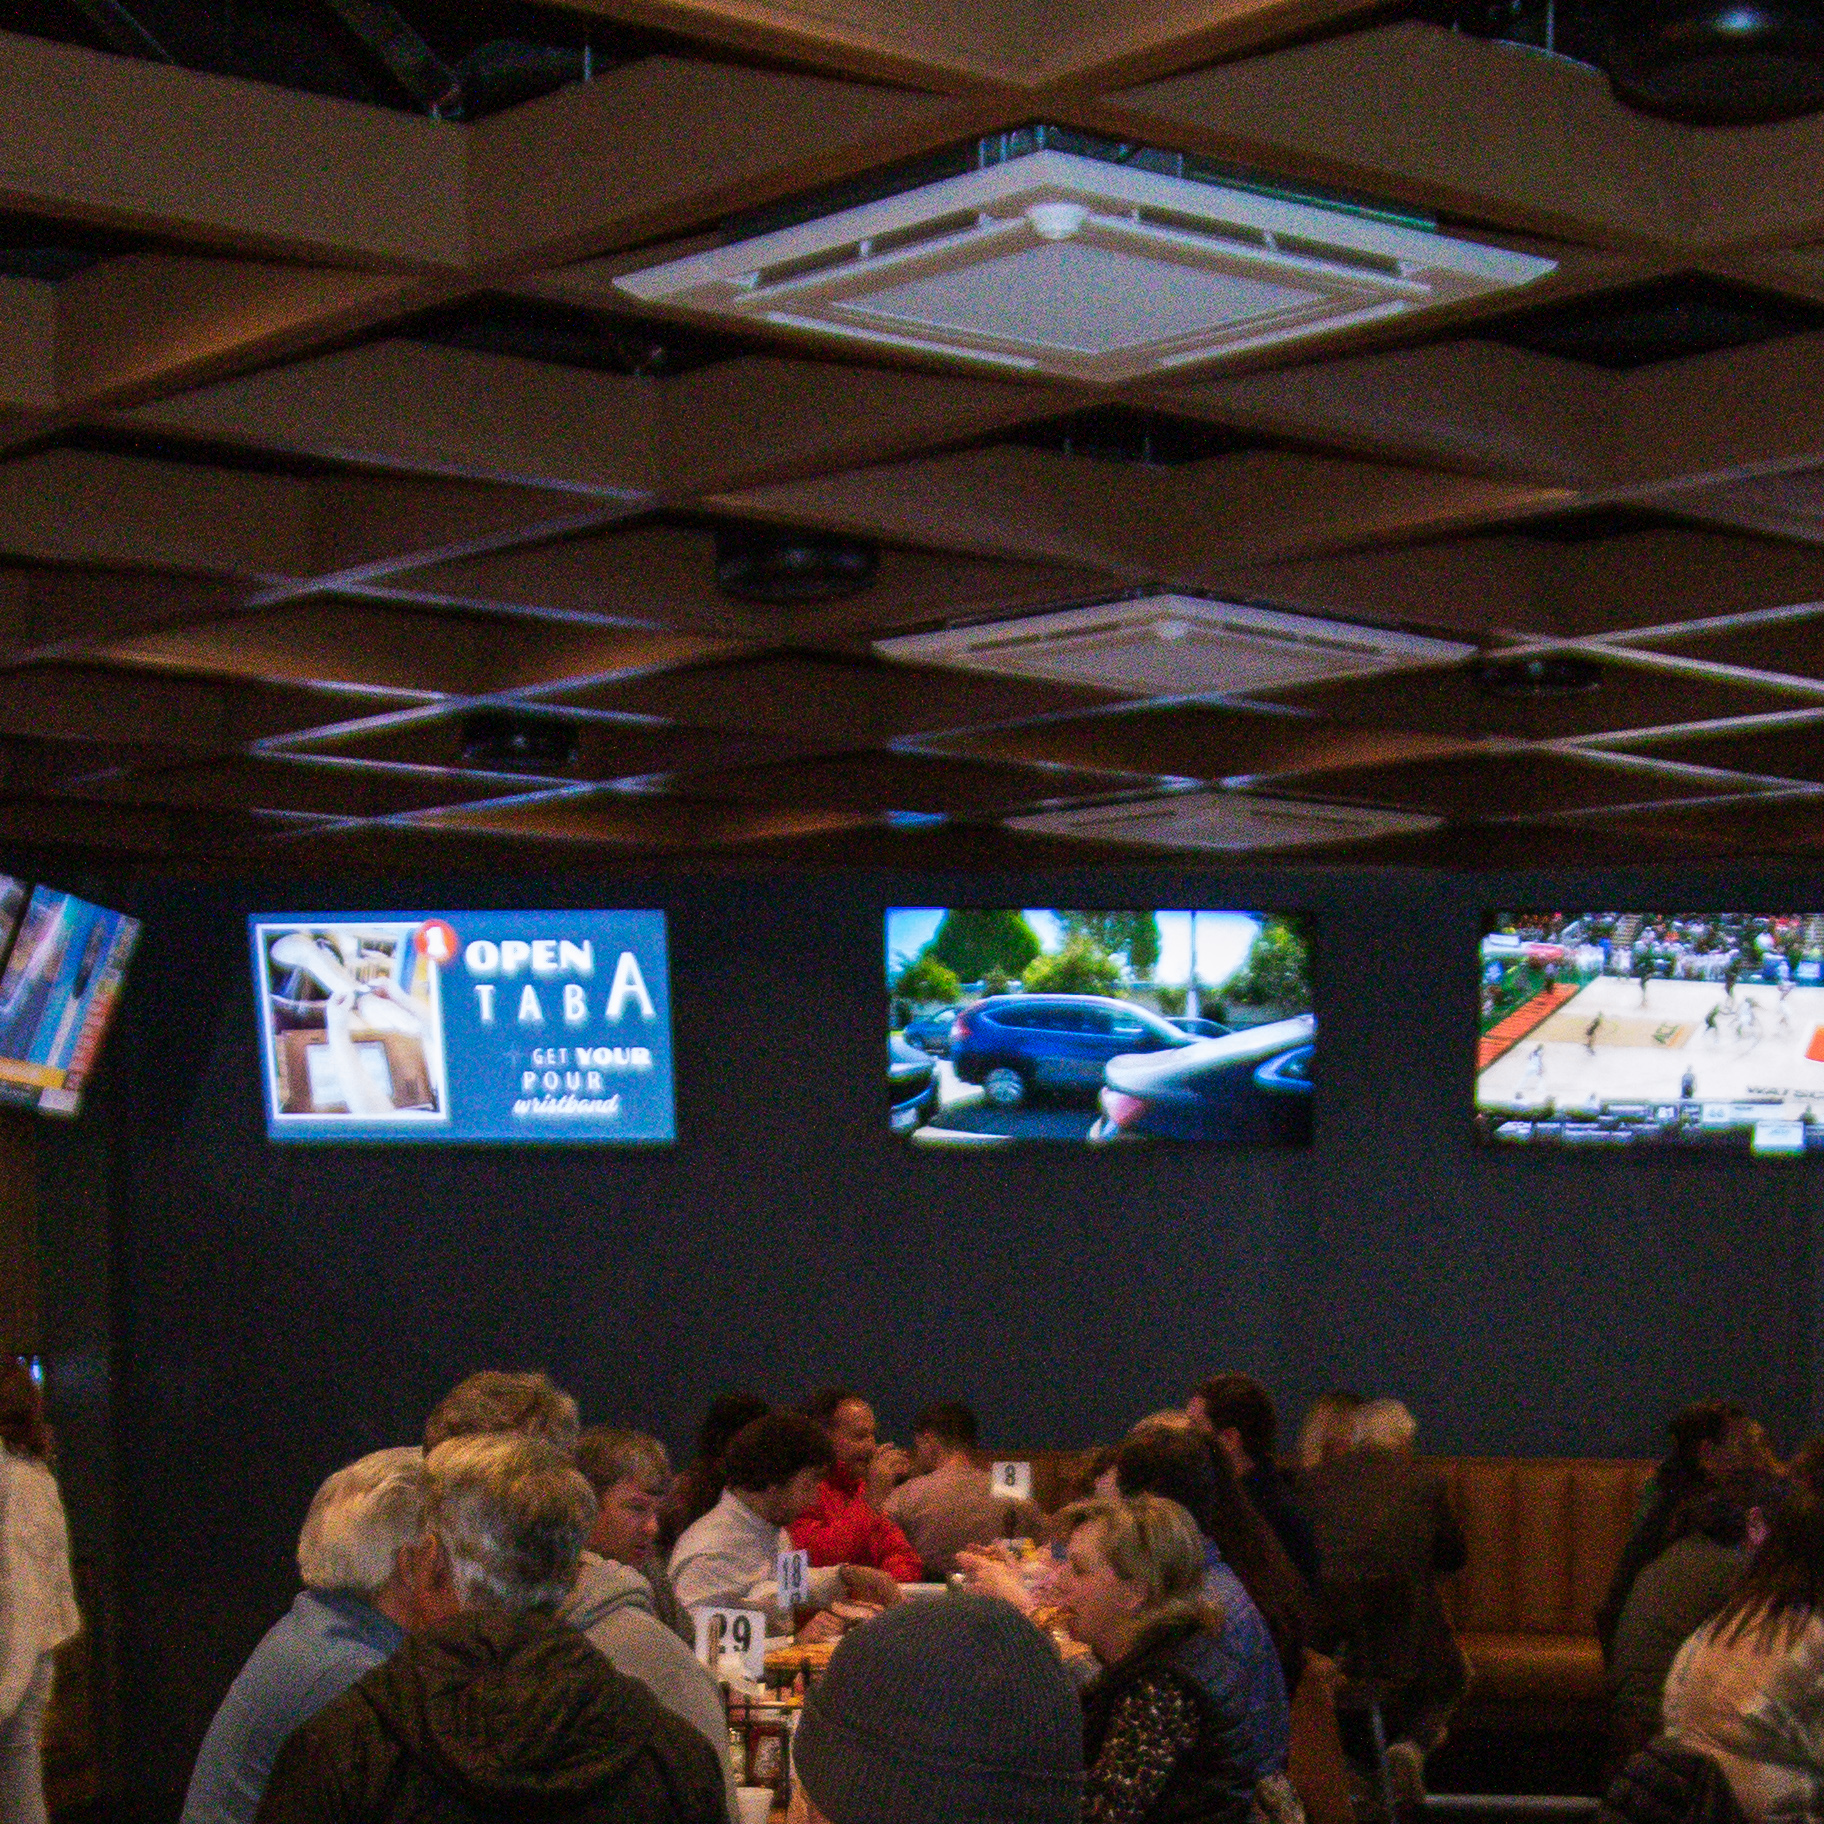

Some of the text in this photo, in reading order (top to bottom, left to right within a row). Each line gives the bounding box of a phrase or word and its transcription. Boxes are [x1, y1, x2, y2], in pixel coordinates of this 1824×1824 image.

[466, 940, 655, 1018] OPEN A
[475, 984, 587, 1022] TAB
[532, 1046, 651, 1067] GET YOUR
[522, 1070, 604, 1091] POUR
[513, 1092, 620, 1116] wristband
